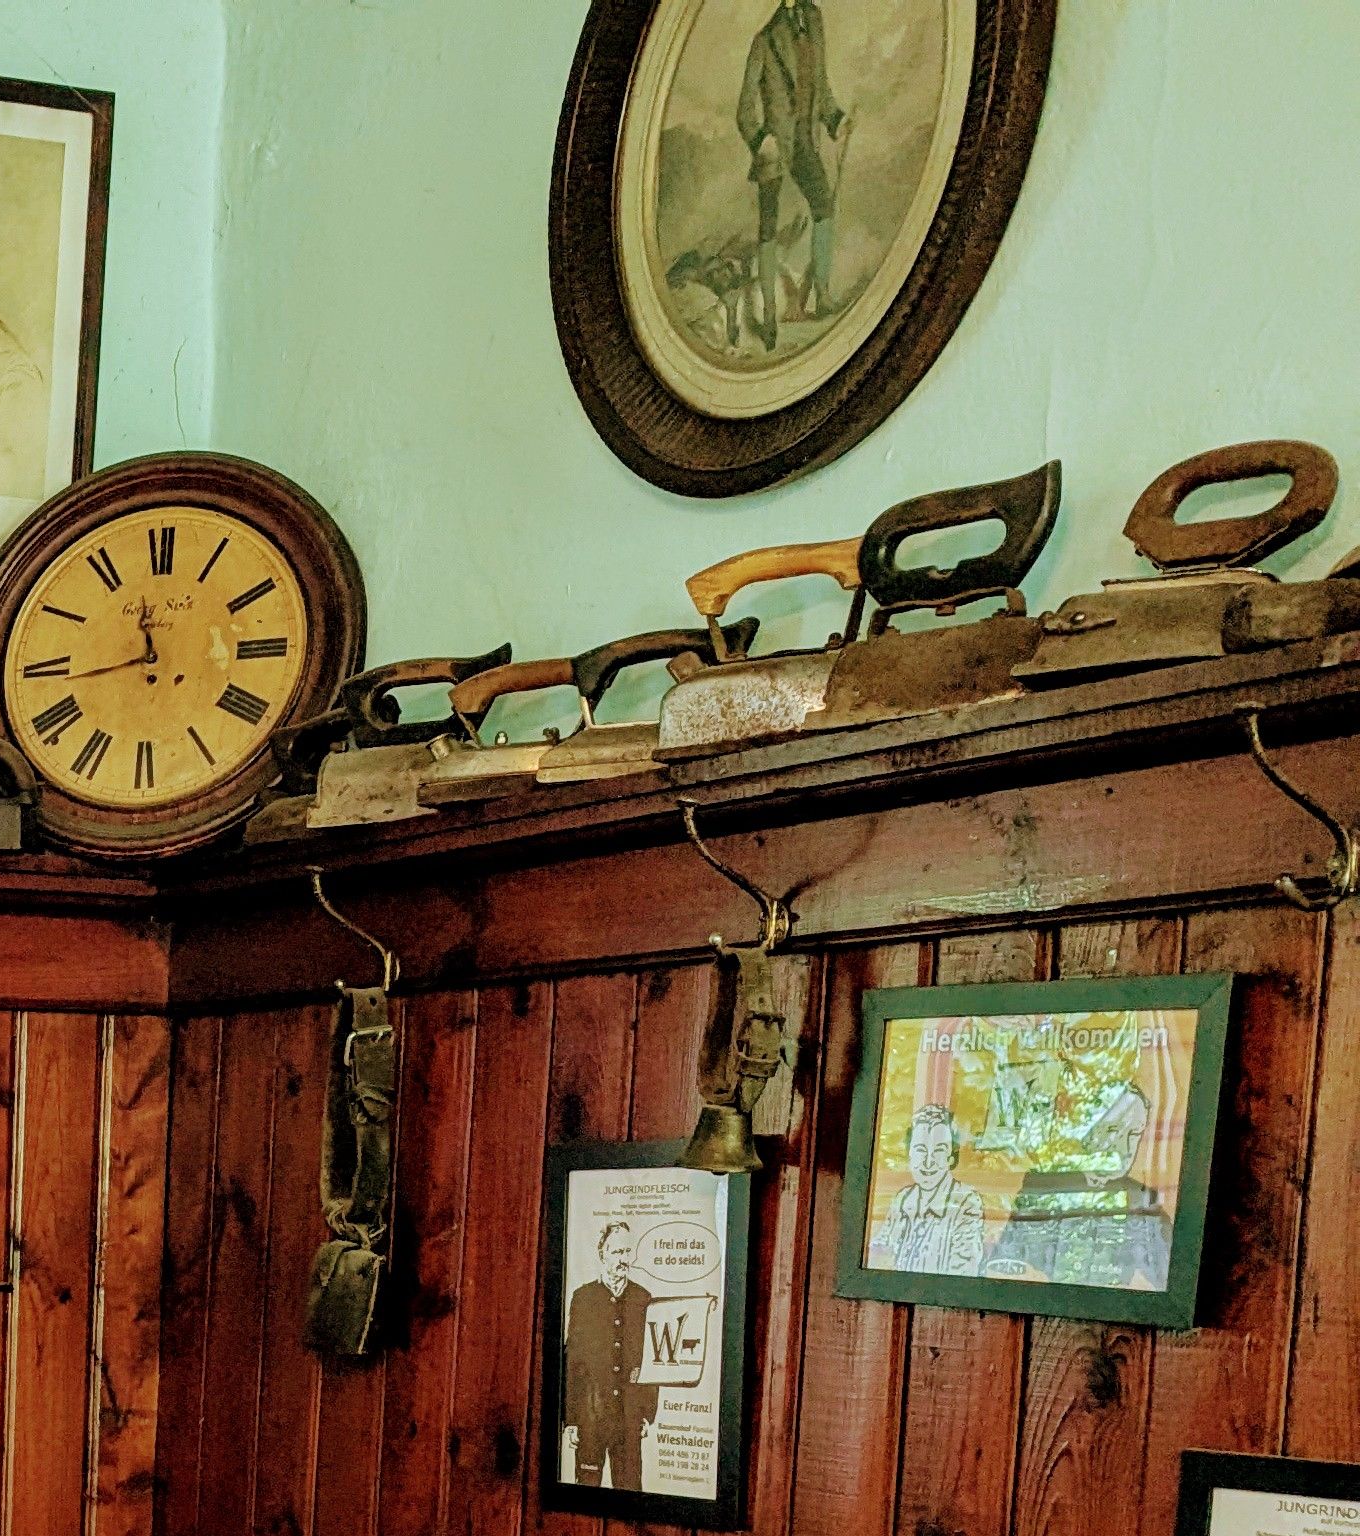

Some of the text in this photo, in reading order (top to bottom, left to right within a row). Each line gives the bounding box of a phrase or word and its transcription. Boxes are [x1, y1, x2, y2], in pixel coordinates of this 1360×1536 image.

[921, 1026, 1009, 1053] Herzlich
[603, 1183, 690, 1196] JUNGRINDFLEISCH
[689, 1238, 706, 1250] das
[665, 1253, 705, 1265] do seids!
[663, 1400, 683, 1412] Euer
[657, 1433, 715, 1448] Wieshaider
[1278, 1500, 1360, 1519] JUNGRIND
